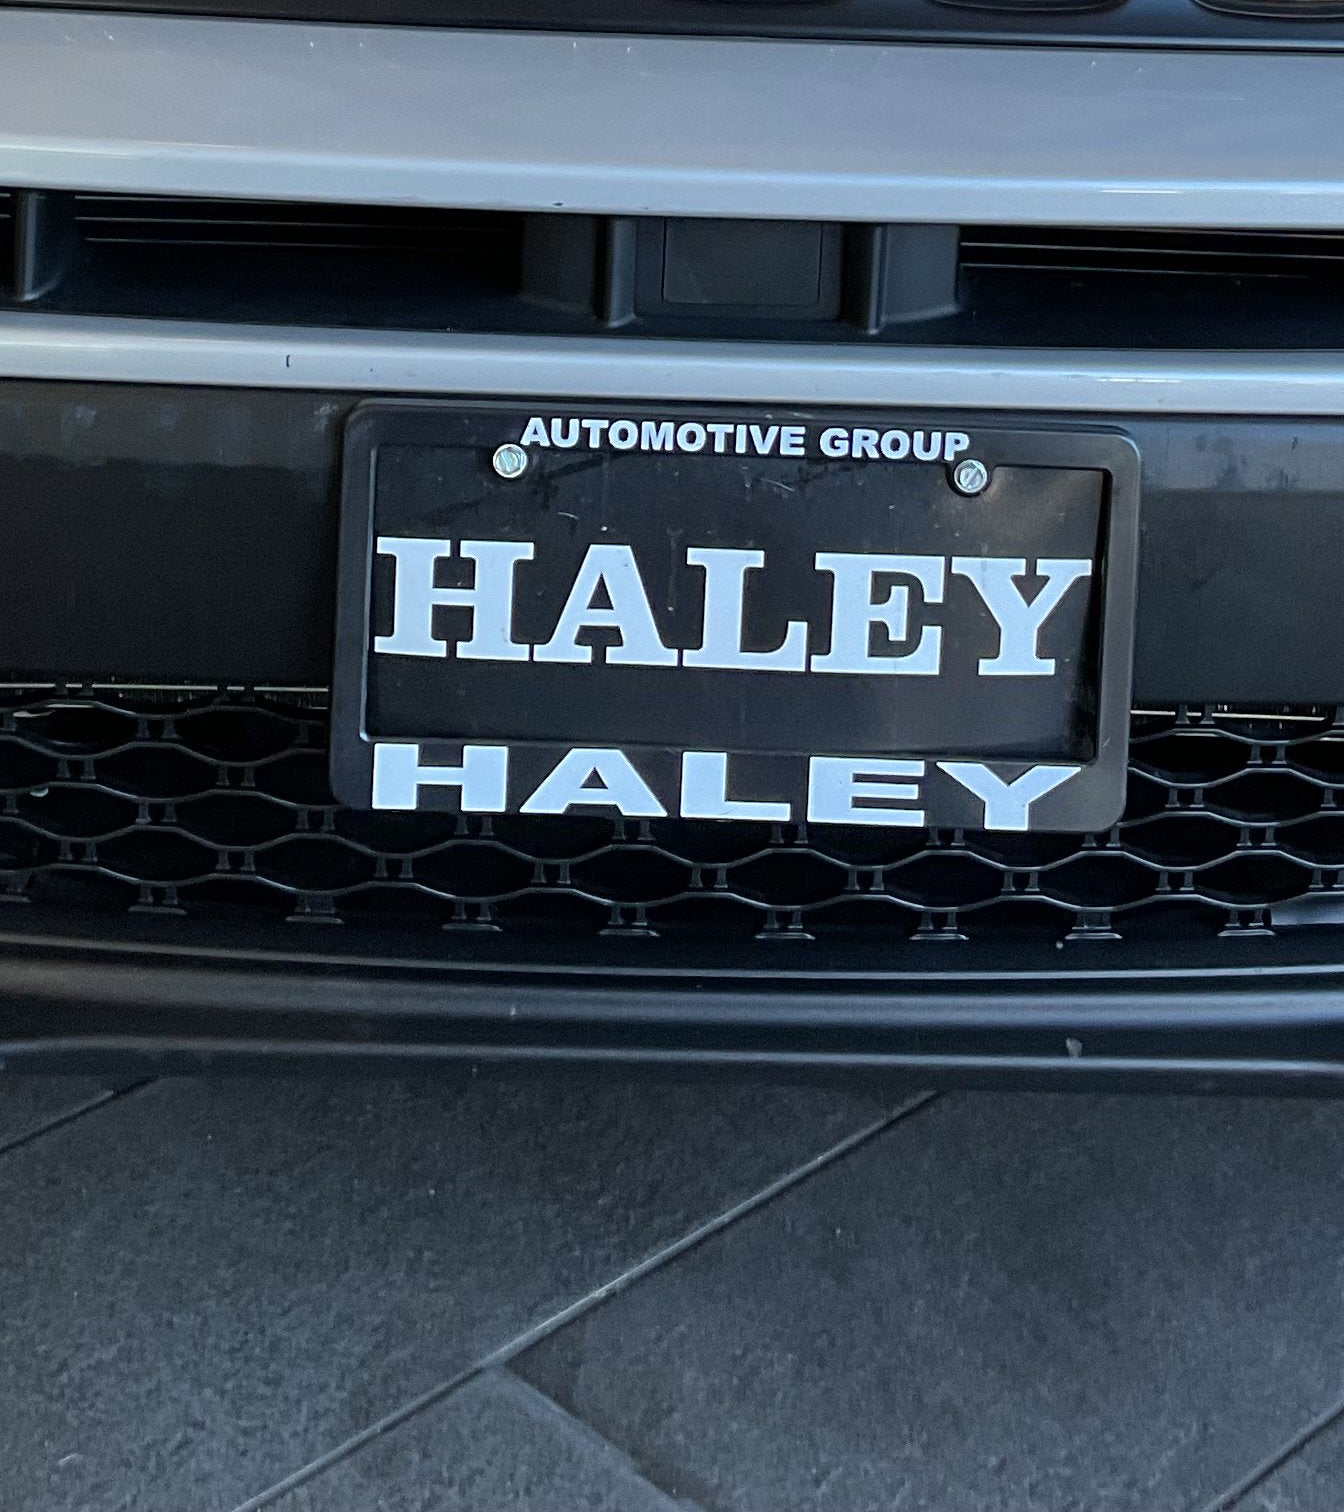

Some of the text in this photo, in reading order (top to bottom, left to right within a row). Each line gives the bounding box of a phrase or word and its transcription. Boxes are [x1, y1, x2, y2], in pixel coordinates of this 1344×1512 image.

[520, 416, 971, 463] AUTOMOTIVE GROUP
[373, 536, 1093, 677] HALEY
[371, 742, 1082, 831] HALEY
